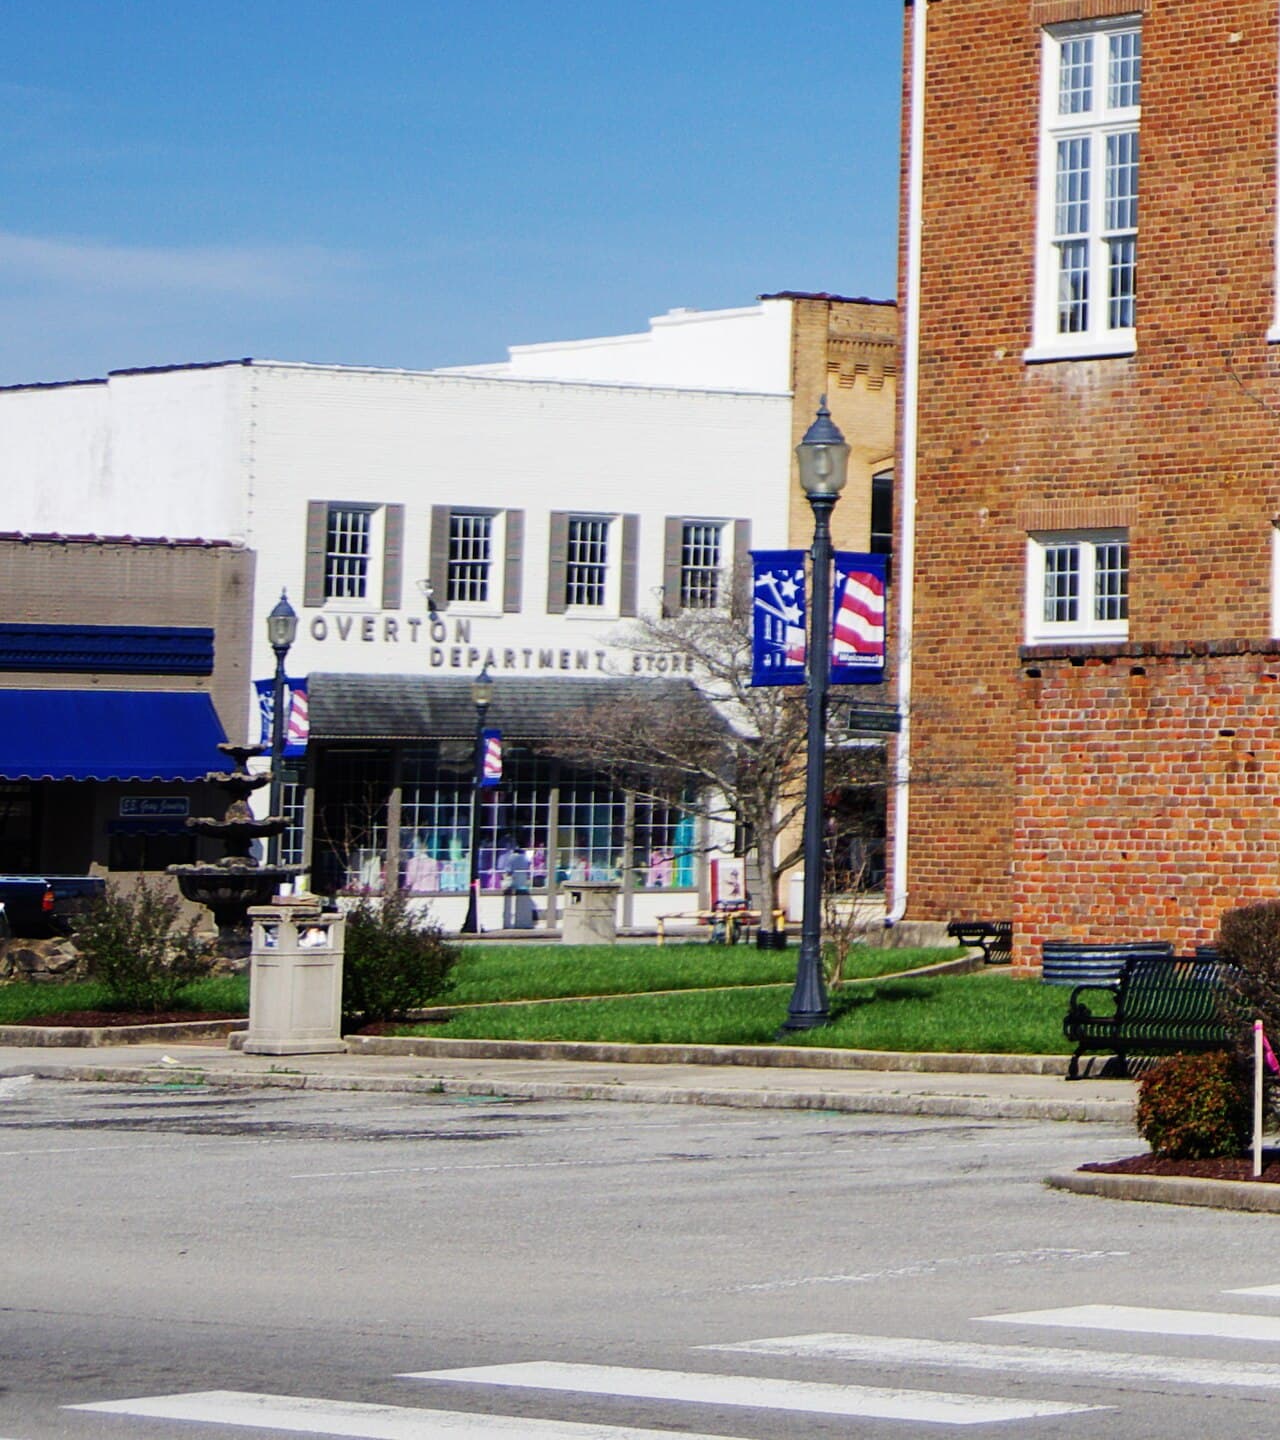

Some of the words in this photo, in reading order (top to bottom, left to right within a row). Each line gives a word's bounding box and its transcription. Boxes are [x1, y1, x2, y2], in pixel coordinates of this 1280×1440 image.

[310, 615, 472, 644] OVERTON
[430, 646, 606, 671] DEPARTMENT
[632, 654, 697, 673] STORE
